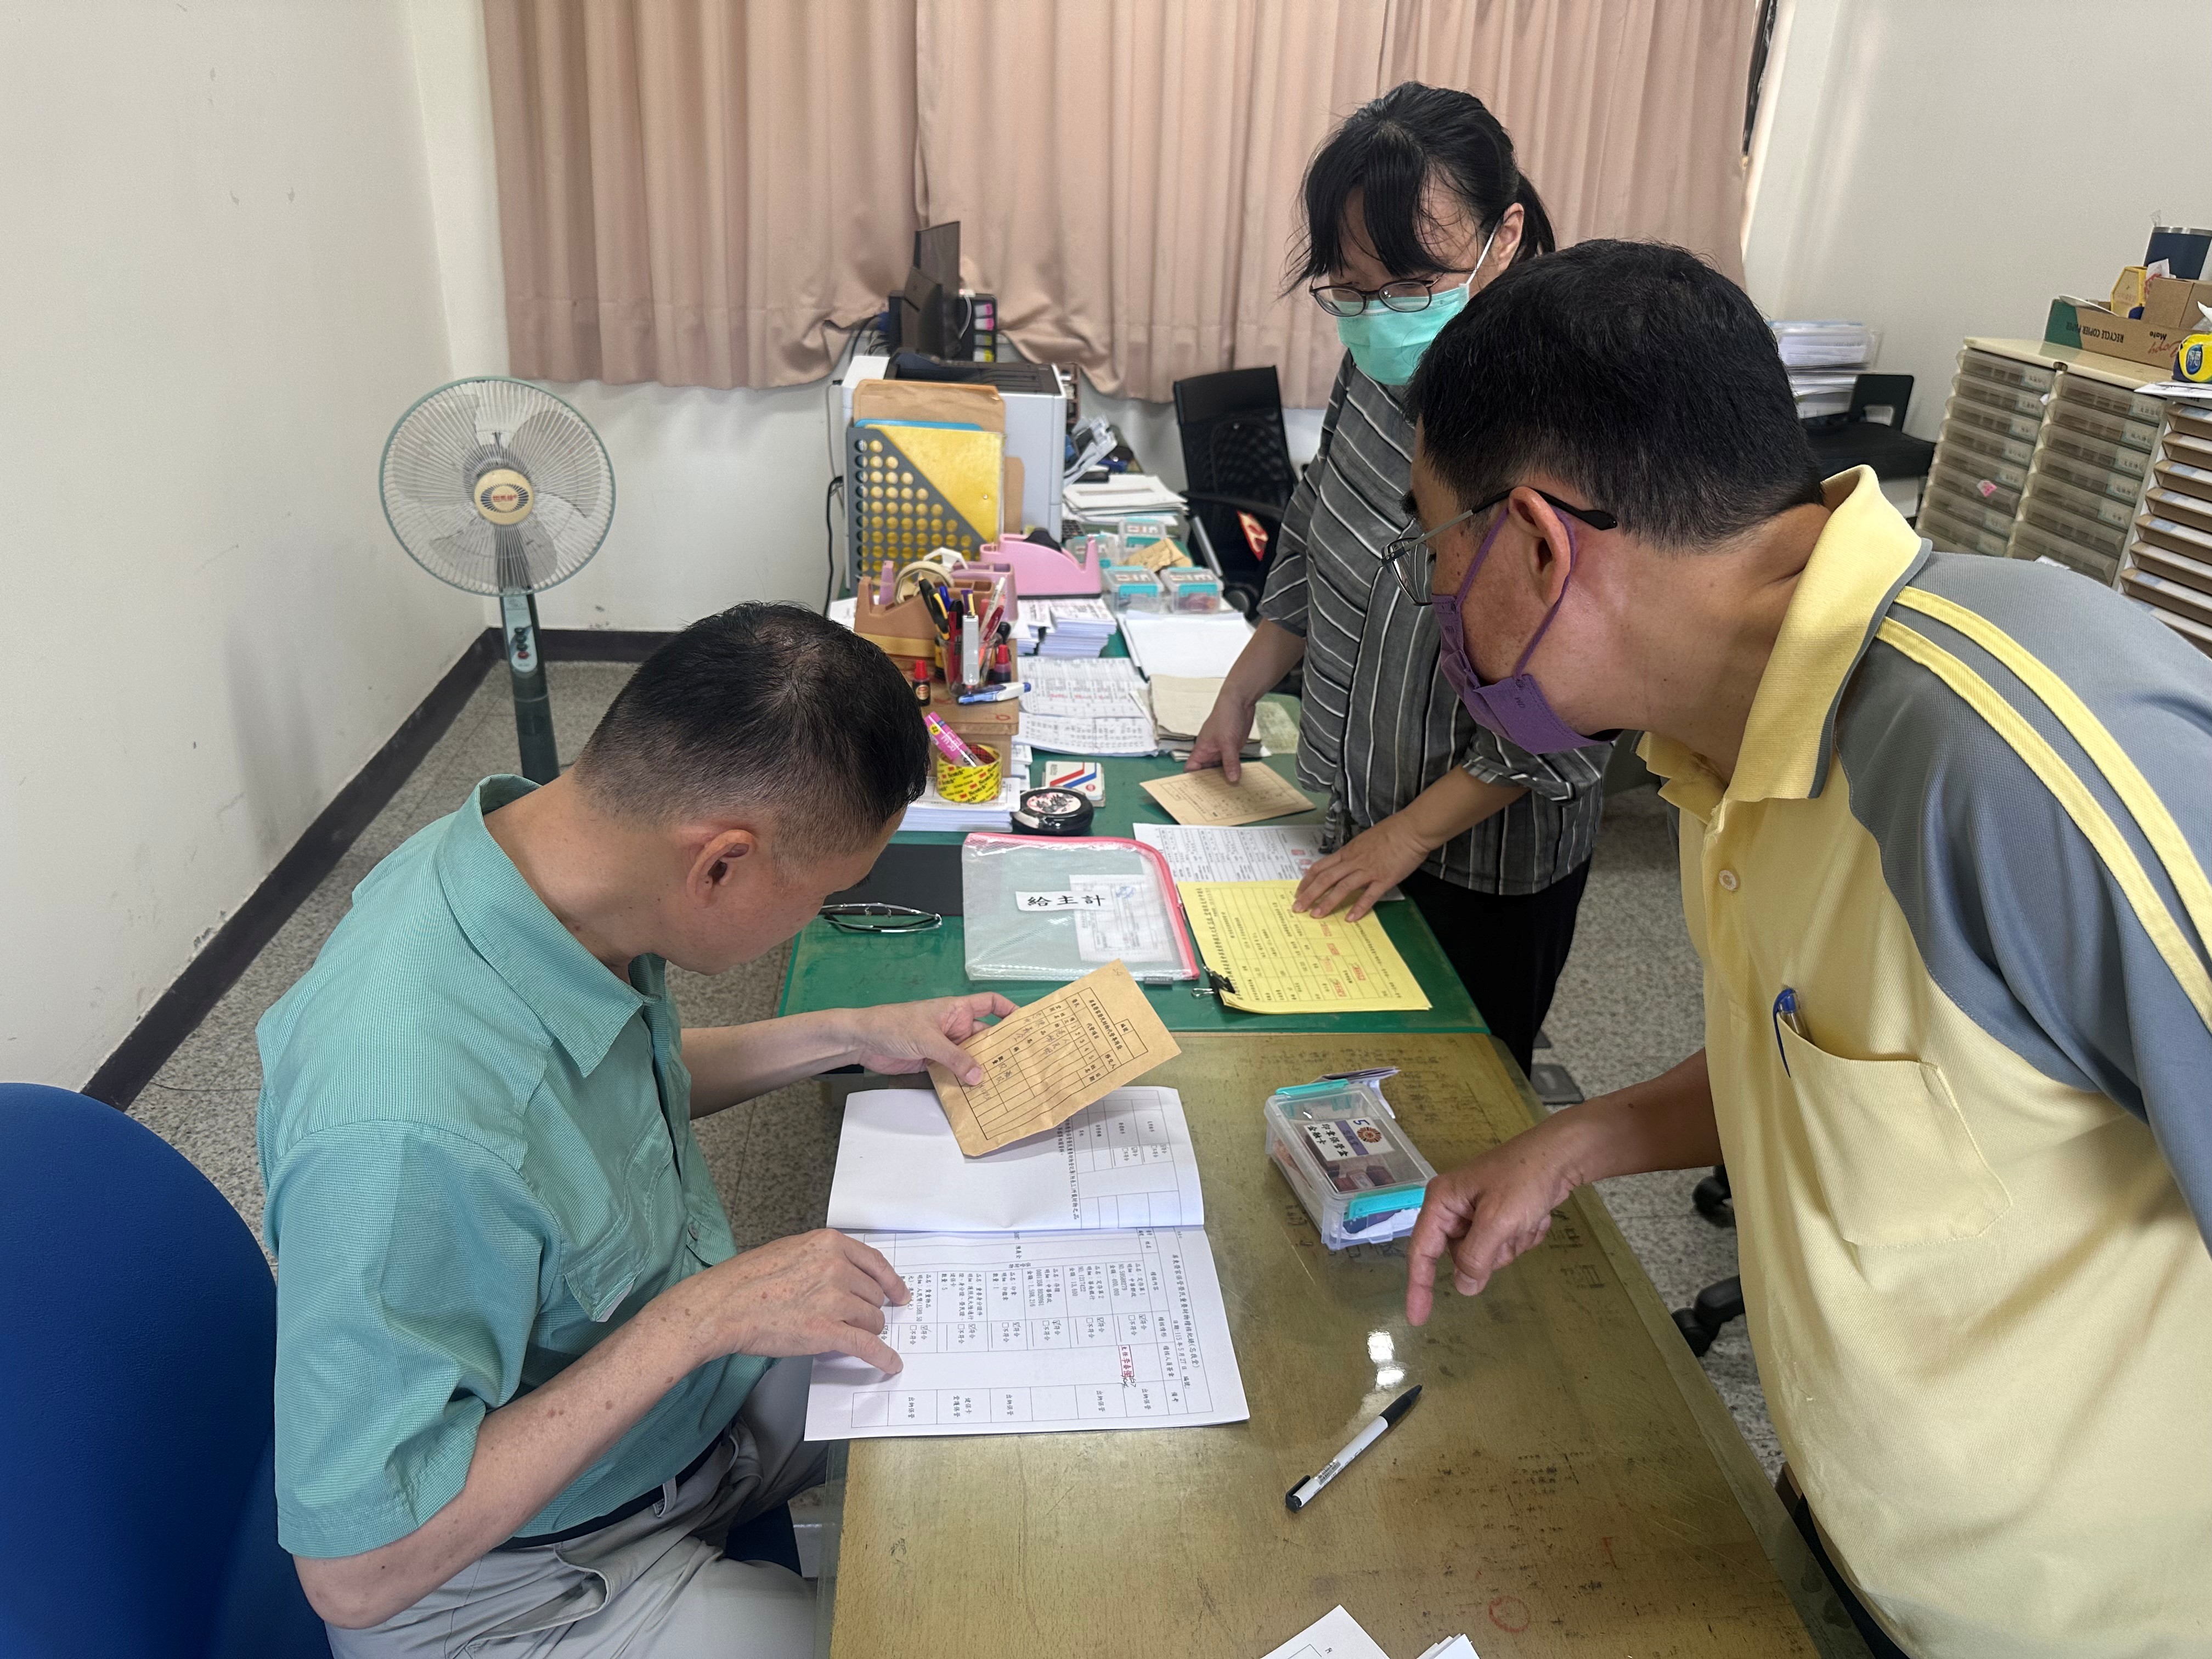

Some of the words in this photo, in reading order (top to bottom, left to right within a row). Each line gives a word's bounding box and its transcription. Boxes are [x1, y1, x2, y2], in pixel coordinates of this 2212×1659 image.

[2082, 326, 2101, 338] COPIER
[2101, 330, 2124, 343] RECYCLE
[2149, 331, 2167, 341] Mate
[1027, 894, 1106, 907] 給主計
[1085, 1022, 1100, 1039] 代管項目
[1104, 1053, 1118, 1069] 移交人
[1042, 1325, 1051, 1341] 不符合
[1086, 1323, 1094, 1338] 不符合
[1128, 1320, 1137, 1336] 不符合
[1158, 1317, 1167, 1337] 稽核情形
[1005, 1393, 1013, 1416] 出納保管
[1096, 1390, 1105, 1412] 出納保管
[1141, 1388, 1151, 1410] 出納保管
[1170, 1391, 1179, 1402] 備考
